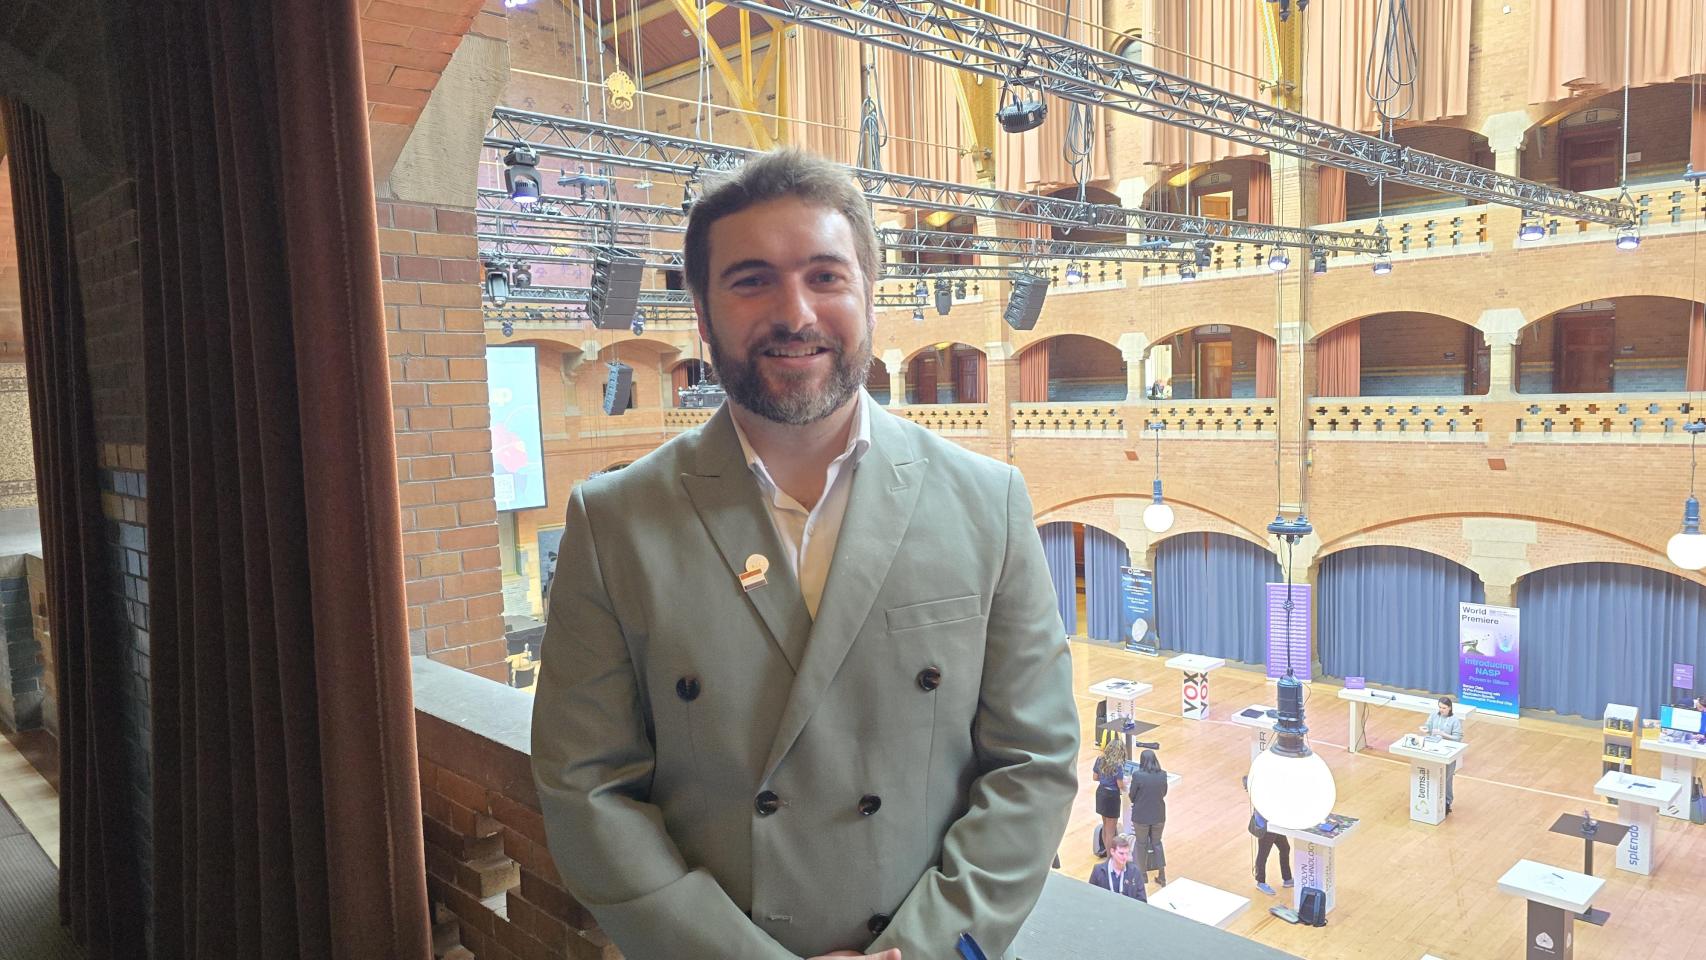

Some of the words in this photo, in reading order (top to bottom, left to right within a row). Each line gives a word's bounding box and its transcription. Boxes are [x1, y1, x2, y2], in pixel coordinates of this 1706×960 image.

[1461, 614, 1499, 625] Premiere
[1462, 606, 1487, 616] World
[1464, 657, 1514, 673] Introducing
[1475, 667, 1501, 677] NASP
[1183, 671, 1199, 713] VOX
[1200, 671, 1209, 715] VOX
[1416, 766, 1426, 799] tems.ai
[1307, 842, 1315, 887] ECHNOLOG
